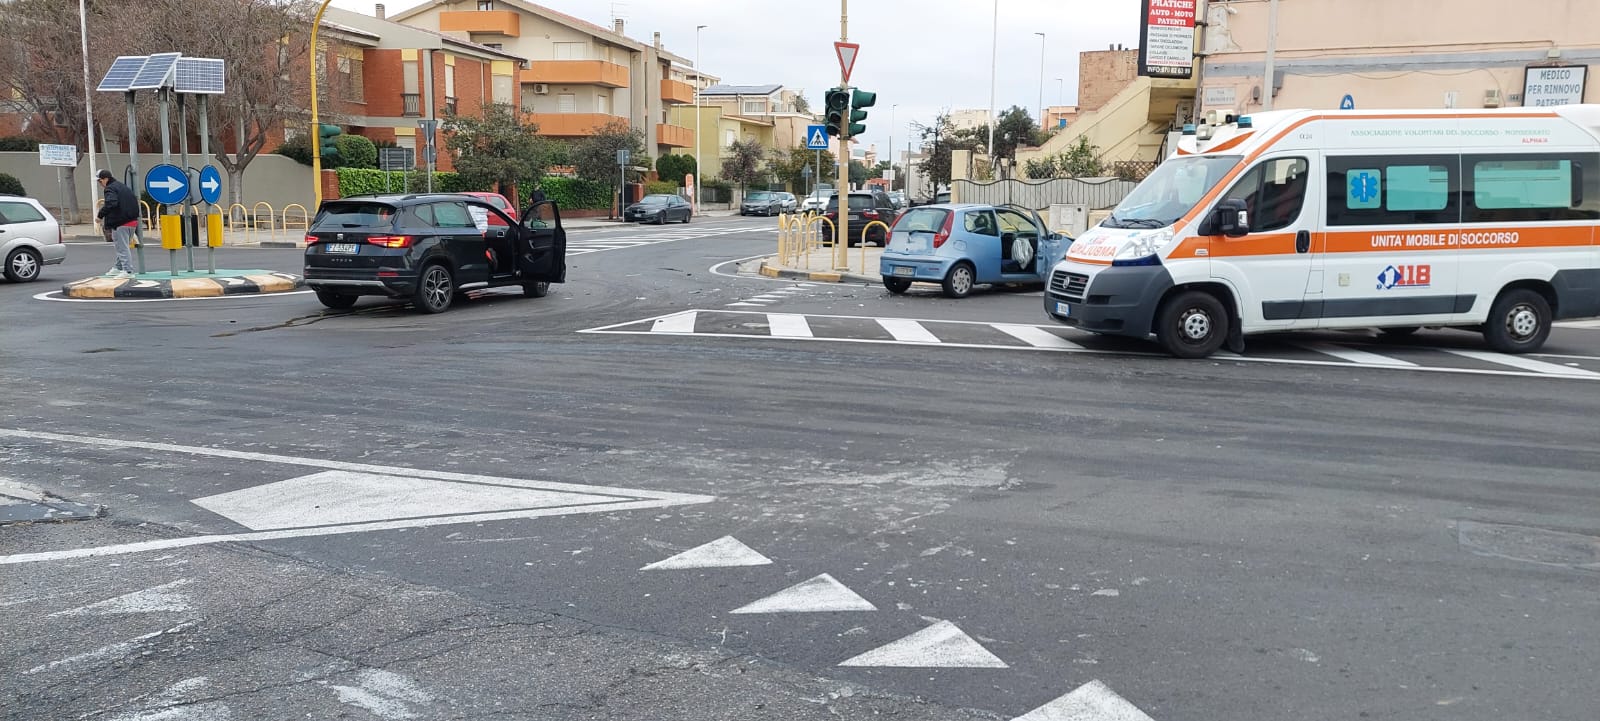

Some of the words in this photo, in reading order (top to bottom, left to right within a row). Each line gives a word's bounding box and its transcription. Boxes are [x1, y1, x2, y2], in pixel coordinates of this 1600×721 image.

[1151, 0, 1194, 8] PRATICHE
[1540, 70, 1571, 80] MEDICO
[1528, 84, 1541, 95] PER
[1543, 83, 1581, 94] RINNOVO
[1371, 235, 1404, 247] UNITA'
[1406, 234, 1446, 246] MOBILE
[1448, 234, 1459, 245] DI
[1460, 232, 1519, 244] SOCCORSO
[1397, 265, 1431, 285] 118
